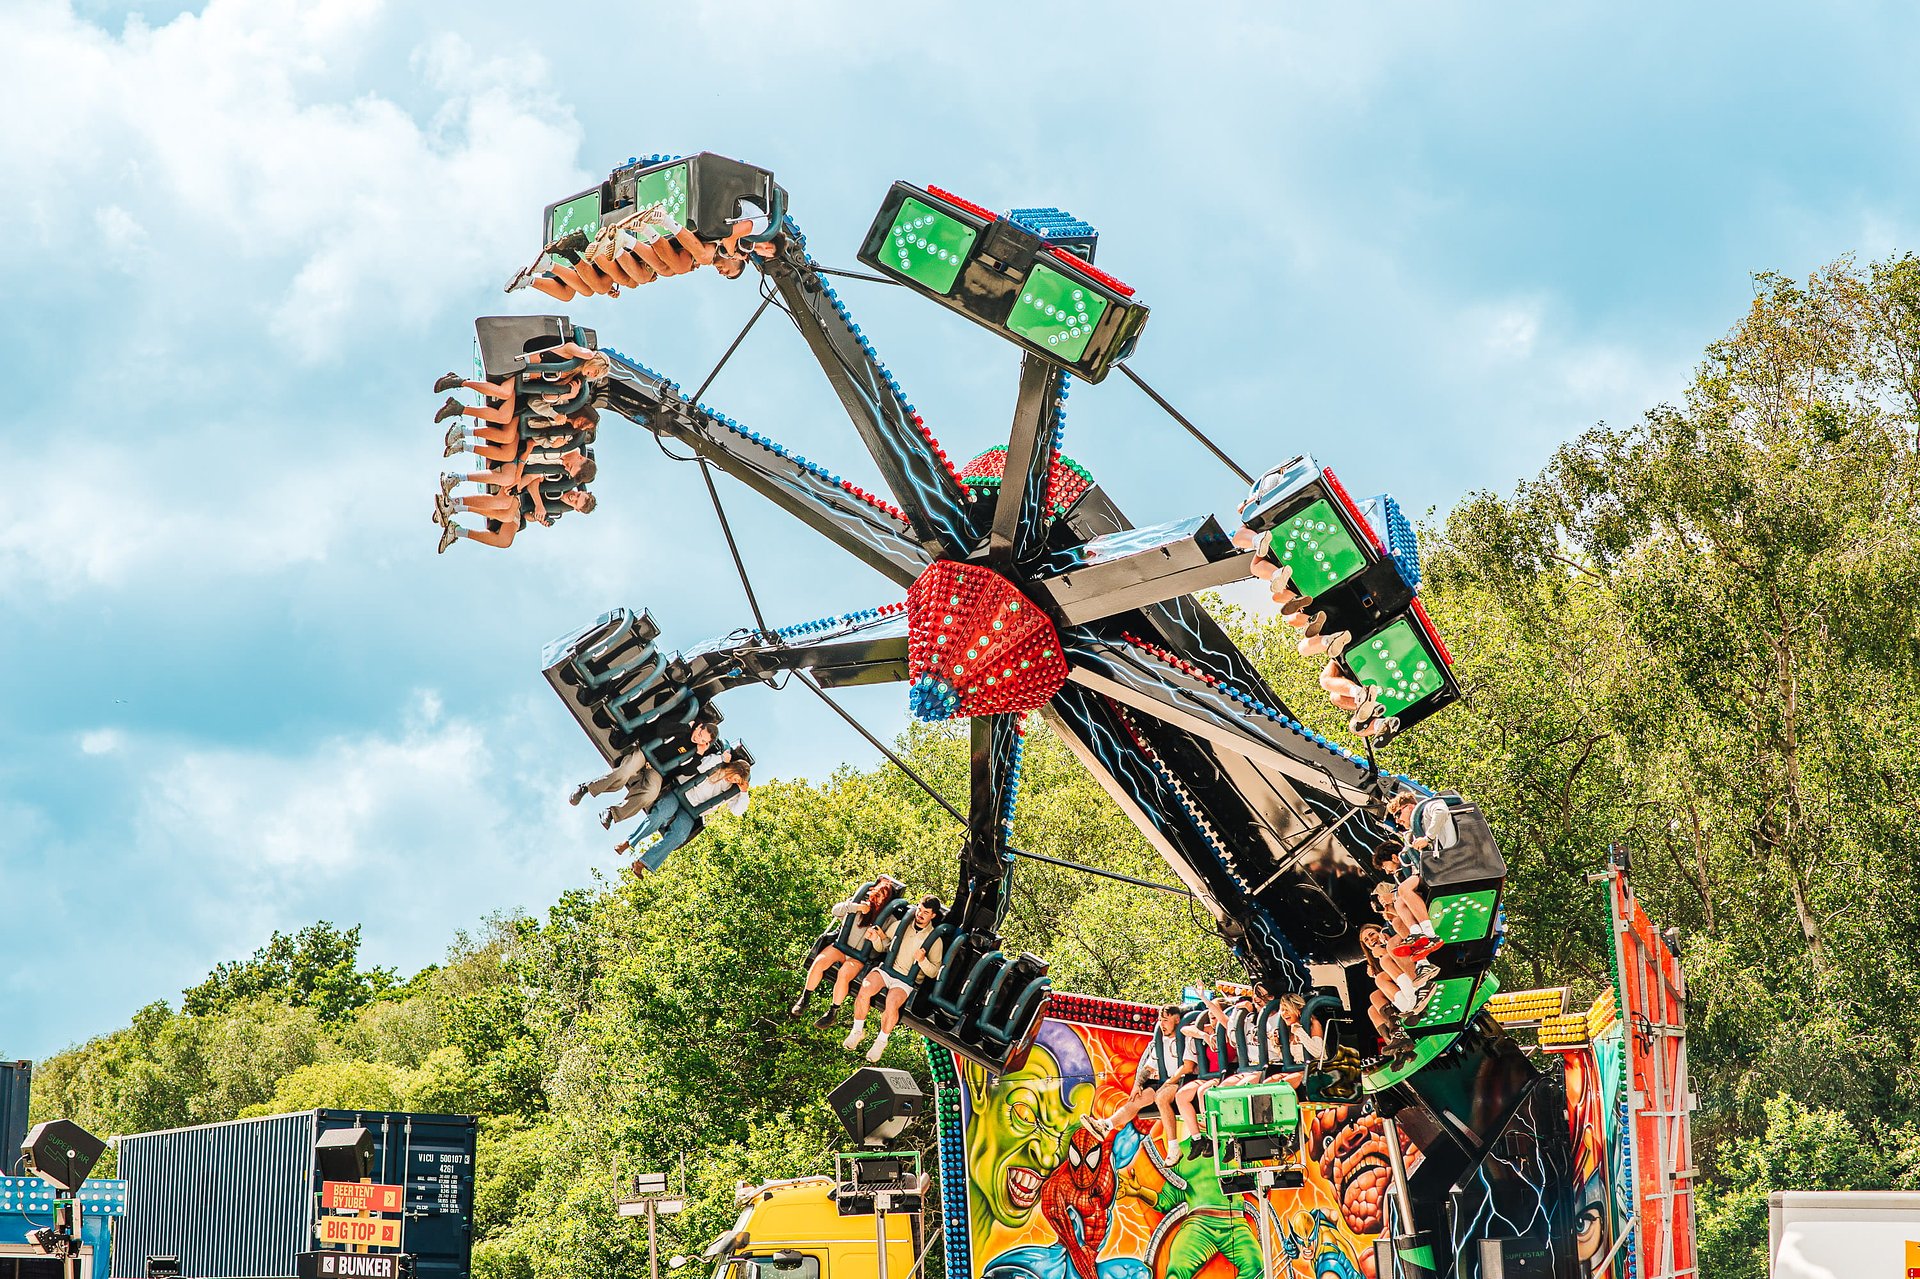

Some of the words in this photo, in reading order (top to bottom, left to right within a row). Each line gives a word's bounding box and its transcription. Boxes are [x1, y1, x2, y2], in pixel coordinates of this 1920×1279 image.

[841, 1082, 880, 1116] SUPRSTAR
[48, 1133, 90, 1164] SUPERTAR
[418, 1153, 434, 1163] VICU
[439, 1154, 463, 1164] 500107
[333, 1184, 354, 1197] BEER
[355, 1186, 375, 1198] TENT
[332, 1196, 344, 1208] BY
[344, 1196, 367, 1209] JUBEL
[327, 1221, 348, 1240] BIG
[351, 1222, 376, 1241] TOP
[338, 1256, 391, 1278] BUNKER
